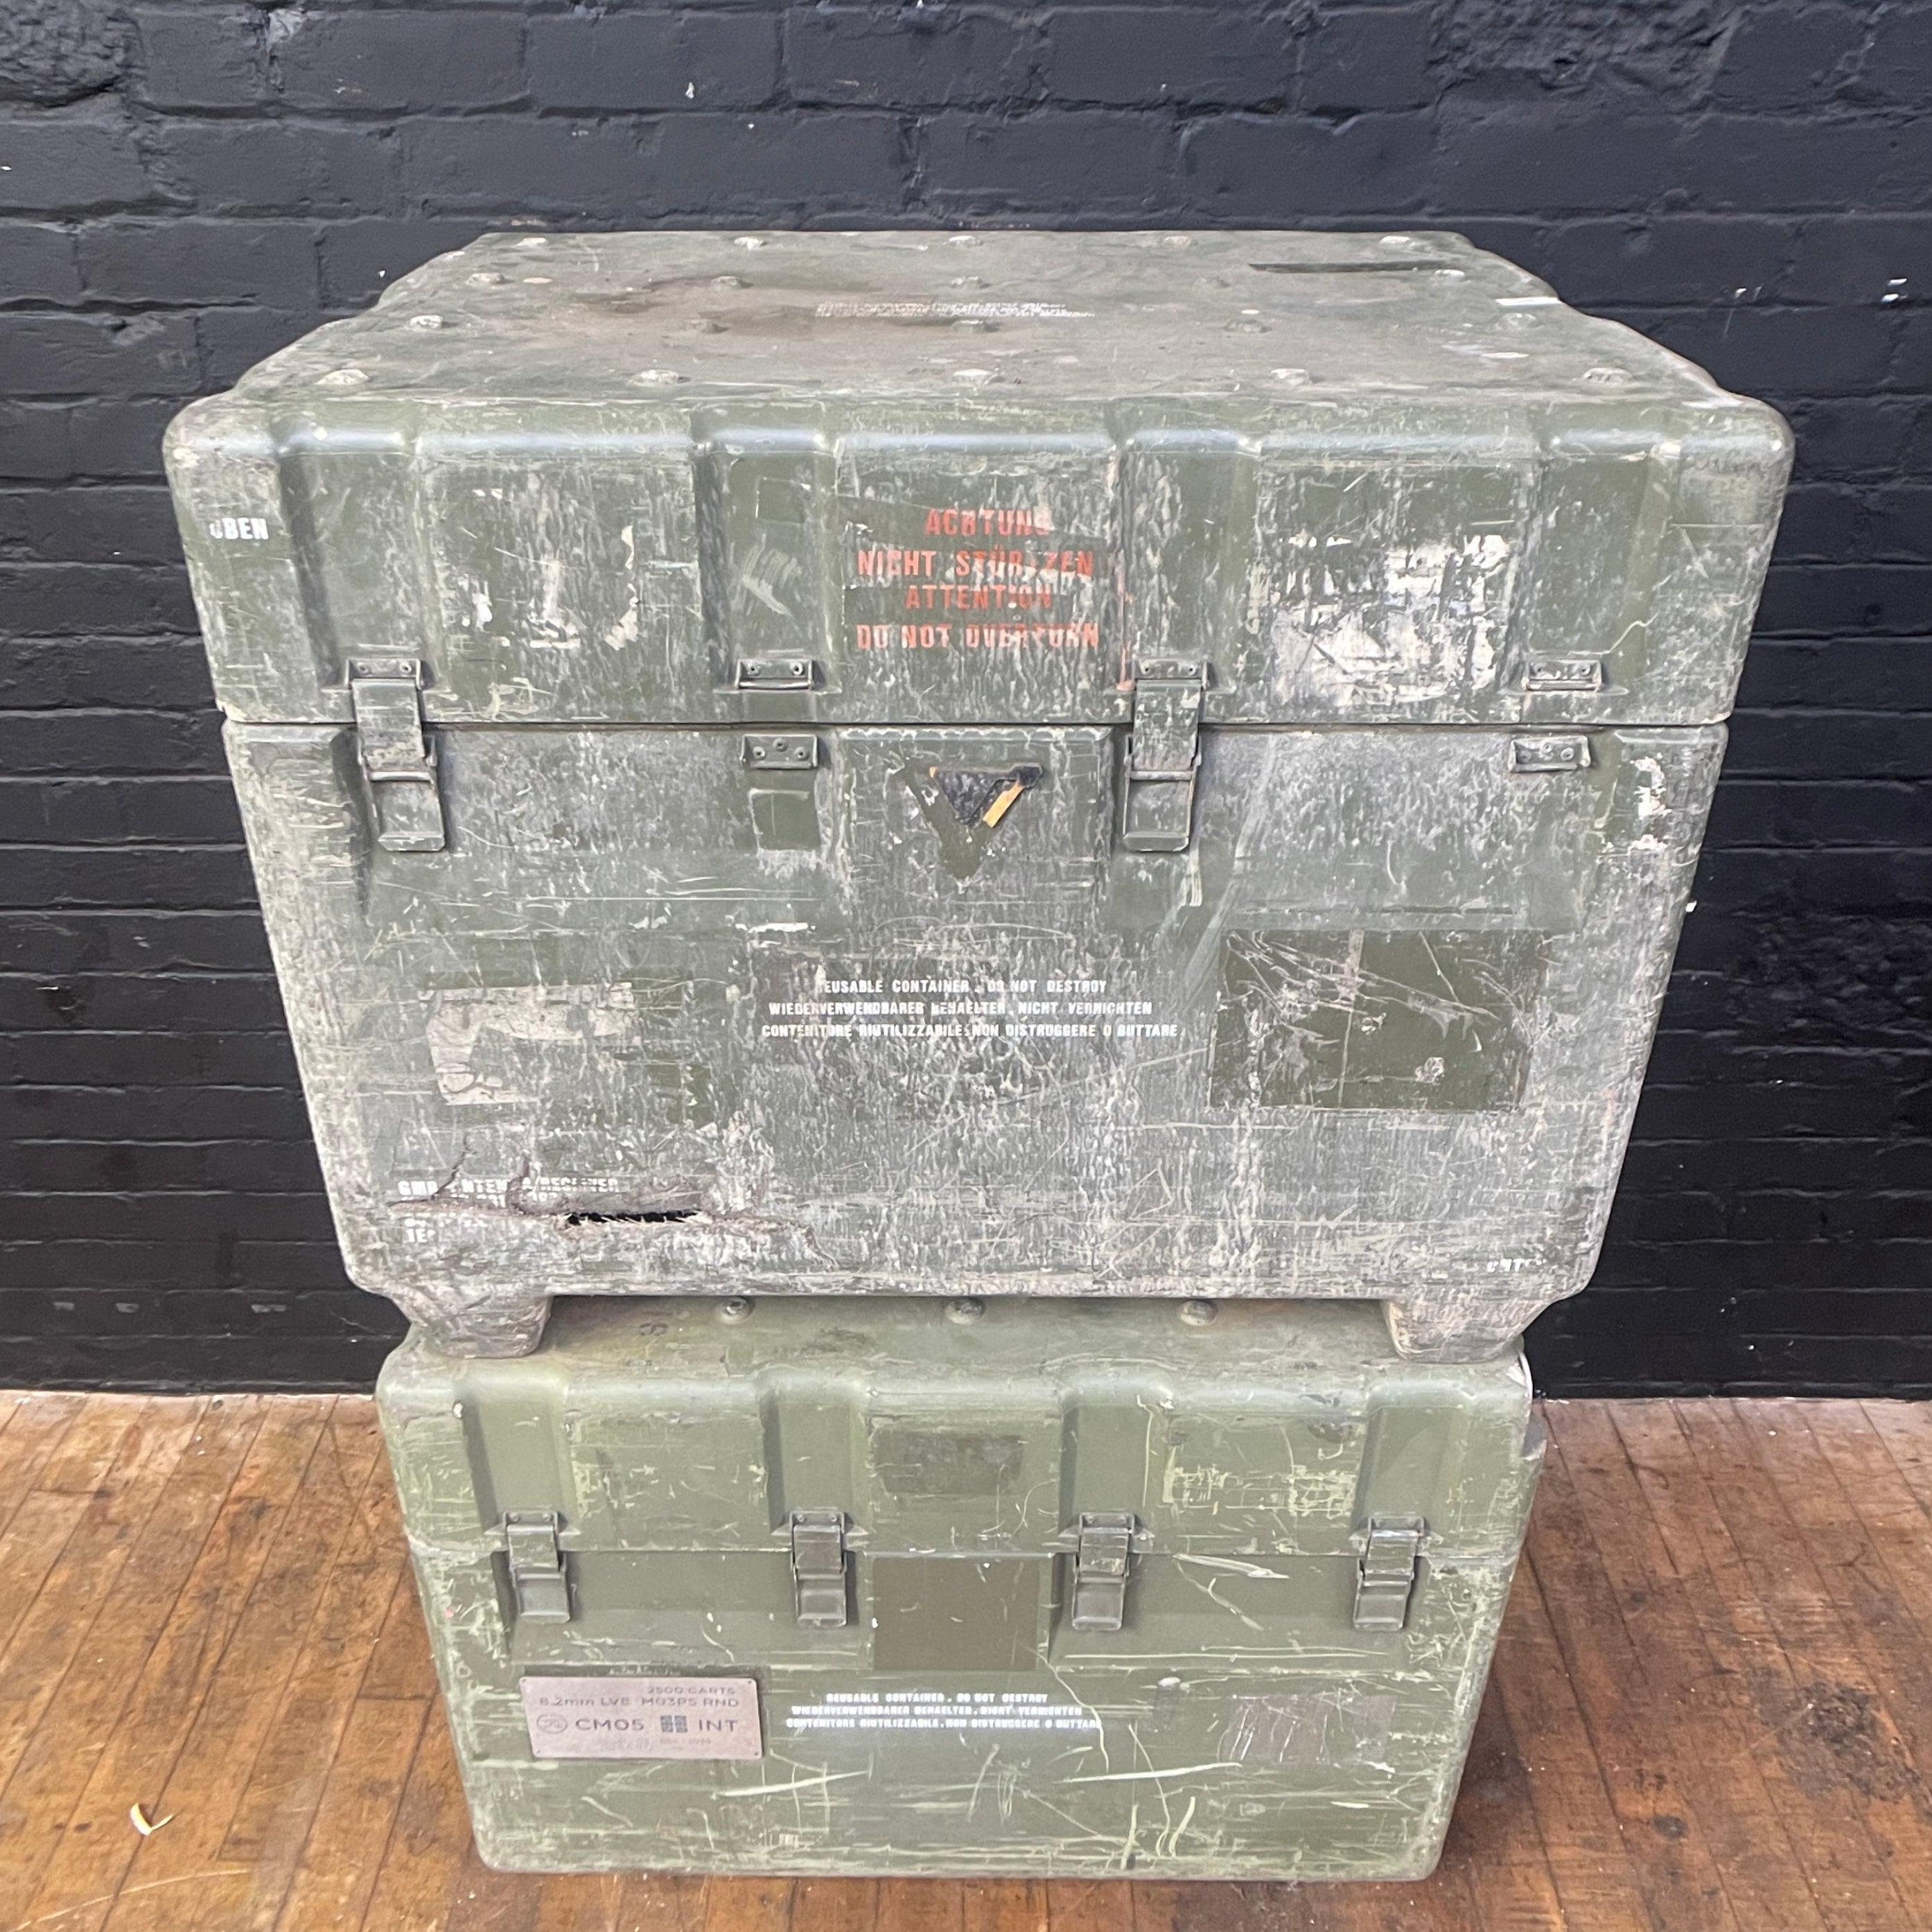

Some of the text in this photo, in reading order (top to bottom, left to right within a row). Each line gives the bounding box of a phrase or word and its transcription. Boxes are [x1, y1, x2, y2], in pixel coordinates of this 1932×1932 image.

[209, 517, 269, 540] OBEN
[857, 550, 936, 576] NICHT
[906, 584, 1052, 609] ATTENTION
[857, 624, 888, 649] DO
[901, 624, 953, 649] NOT
[818, 979, 883, 993] EUSABLE
[987, 979, 1004, 992] DO
[1010, 979, 1037, 993] NOT
[1047, 980, 1107, 993] DESTROY
[1017, 1001, 1059, 1015] NICHT
[972, 1024, 999, 1037] NON
[1117, 1024, 1178, 1037] BUTTARE
[648, 1686, 684, 1695] 2500
[974, 1694, 996, 1703] NOT
[699, 1719, 739, 1732] INT
